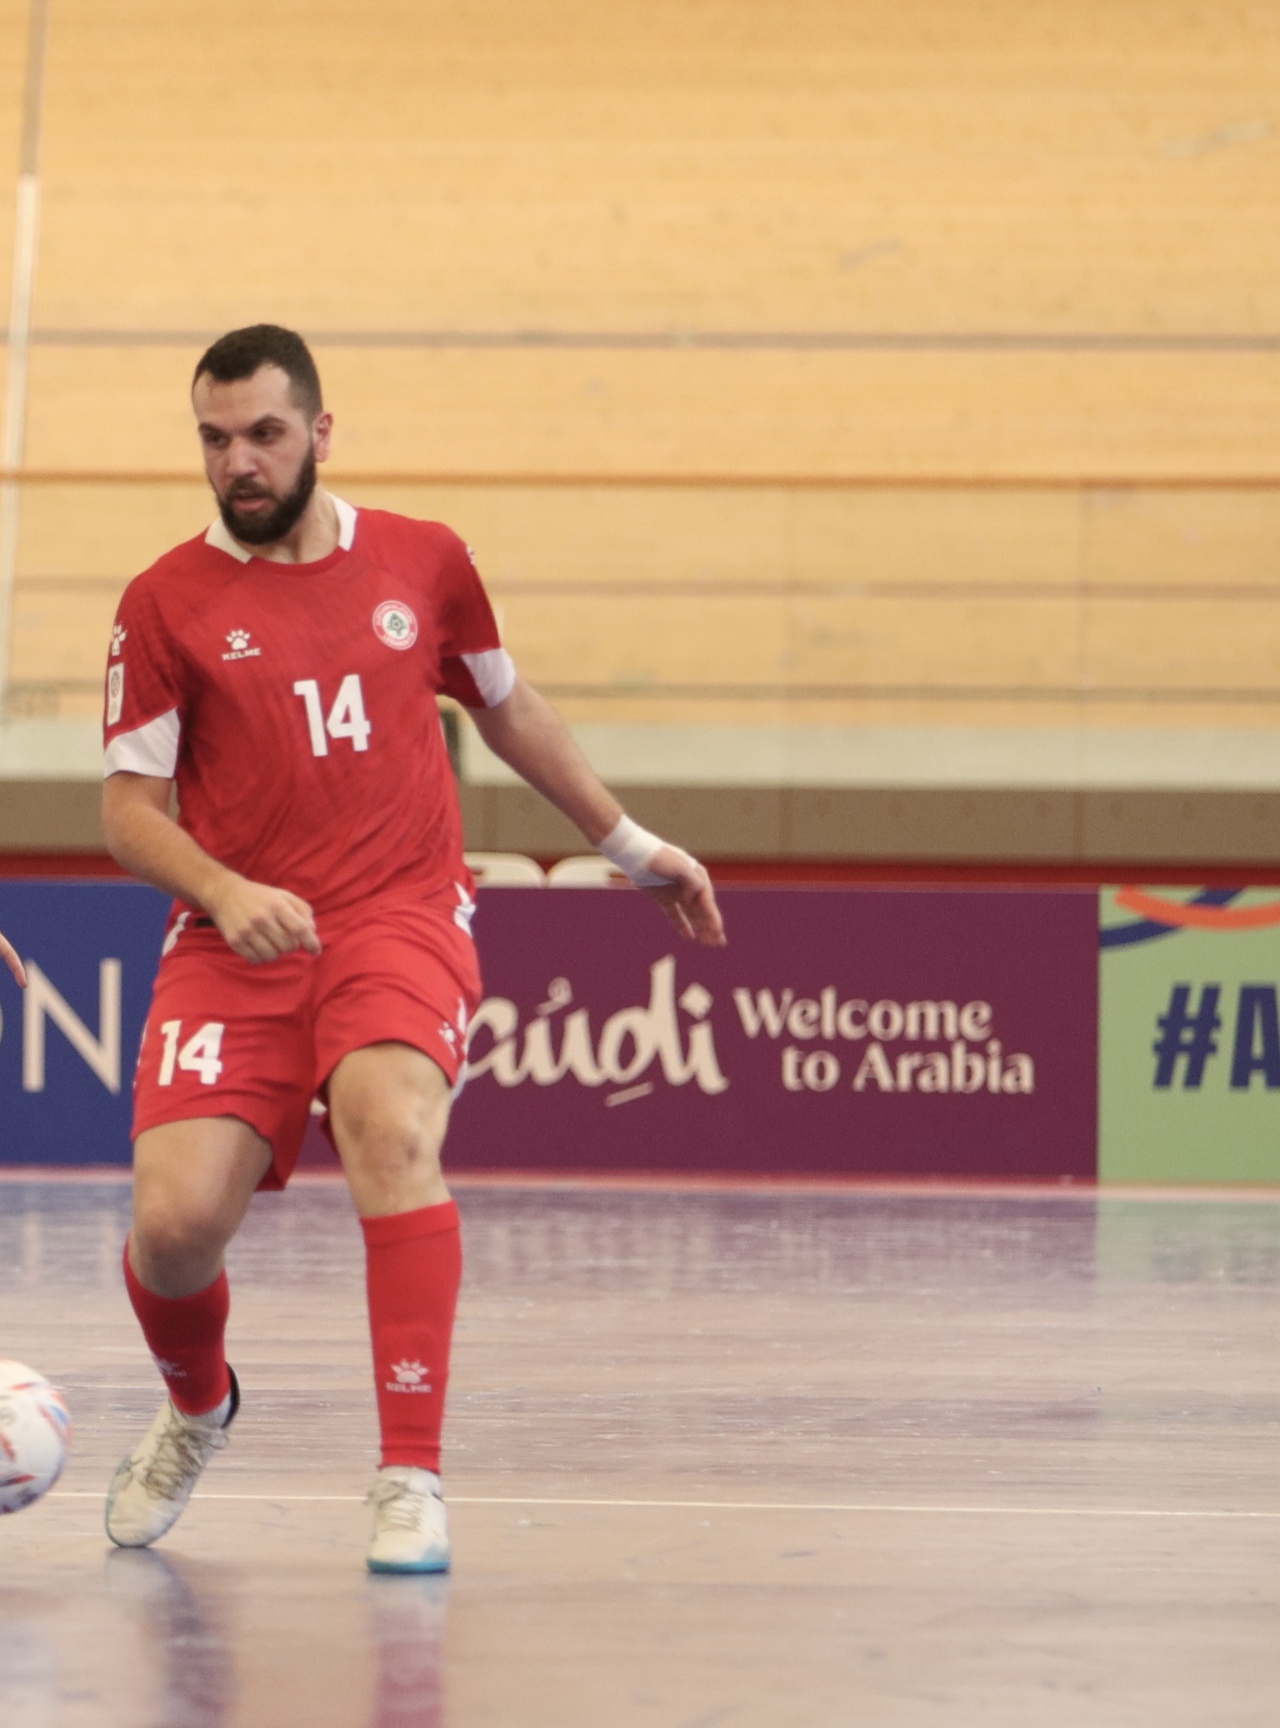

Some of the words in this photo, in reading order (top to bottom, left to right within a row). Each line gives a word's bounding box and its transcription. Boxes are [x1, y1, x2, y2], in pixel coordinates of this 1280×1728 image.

[293, 674, 371, 757] 14
[732, 985, 993, 1042] Welcome
[158, 1019, 225, 1087] 14
[782, 1045, 841, 1092] to
[852, 1038, 1035, 1095] Arabia
